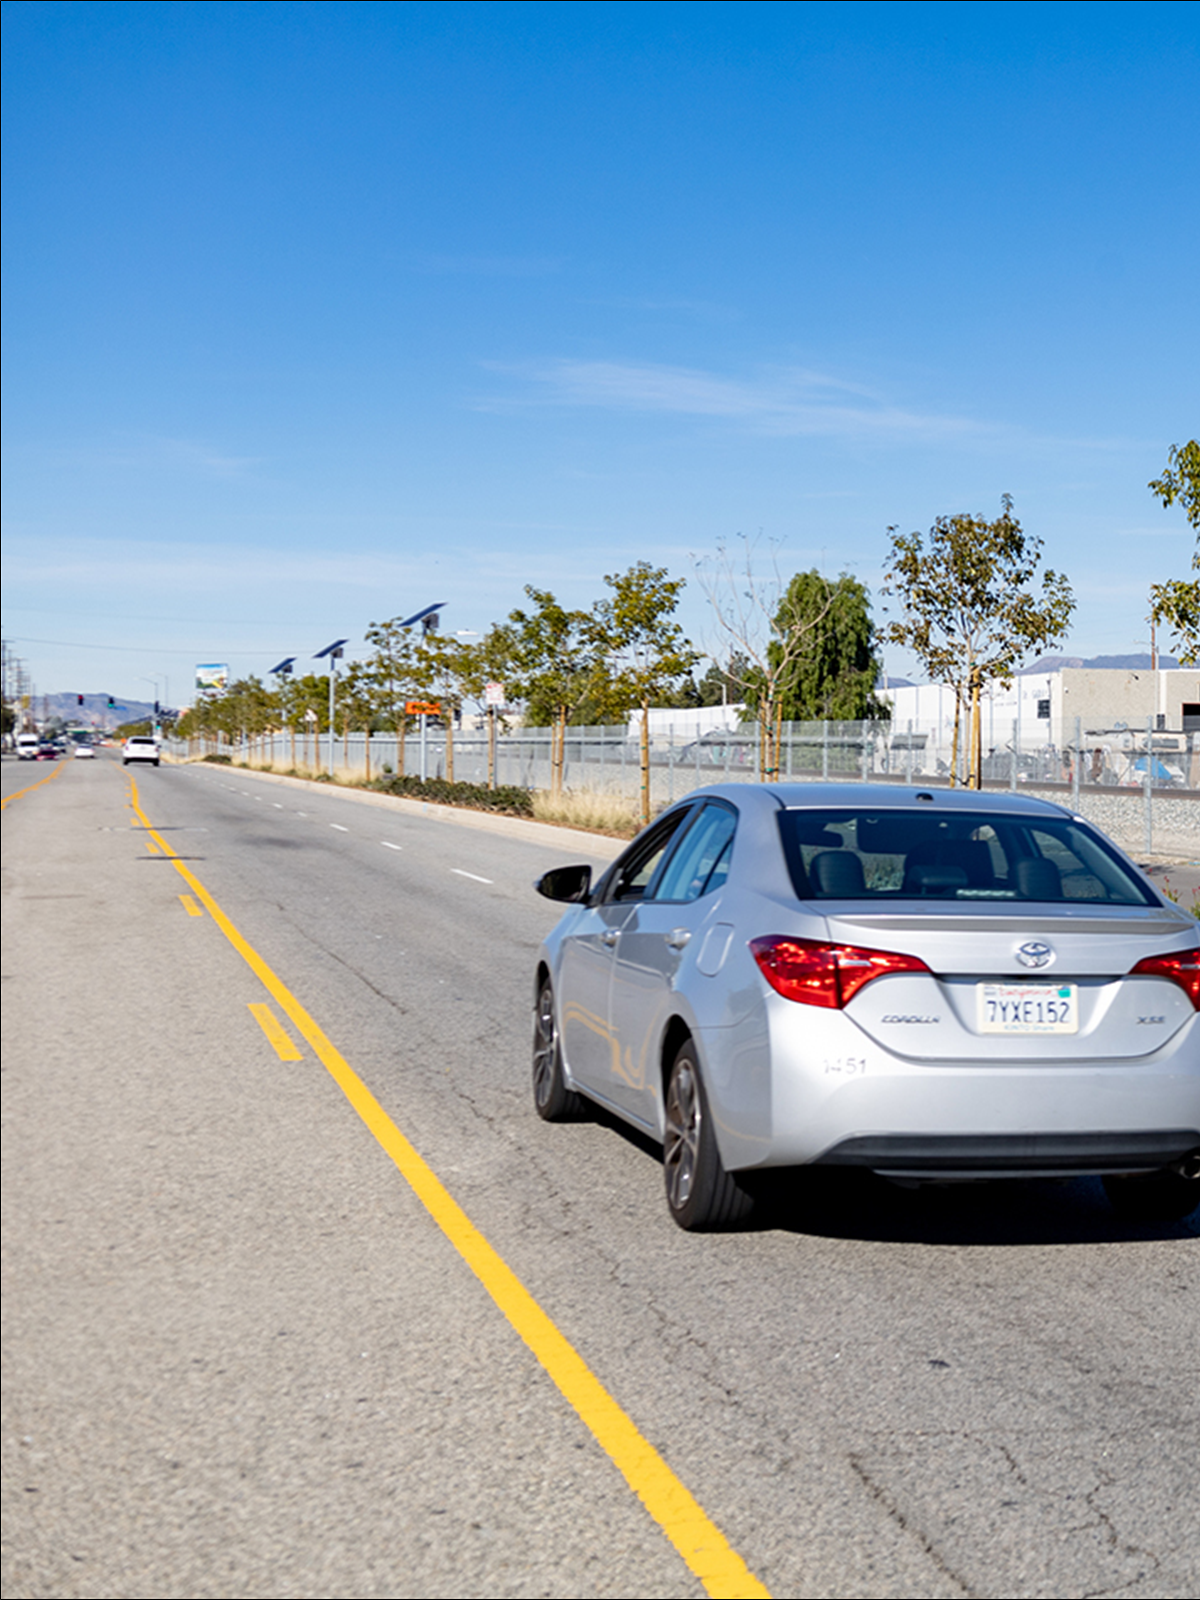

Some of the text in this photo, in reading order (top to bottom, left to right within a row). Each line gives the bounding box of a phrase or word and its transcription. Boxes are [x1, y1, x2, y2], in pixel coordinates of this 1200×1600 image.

[986, 1000, 1070, 1023] 7YXE152
[881, 1015, 941, 1024] COROLLA
[1136, 1016, 1166, 1025] XSE
